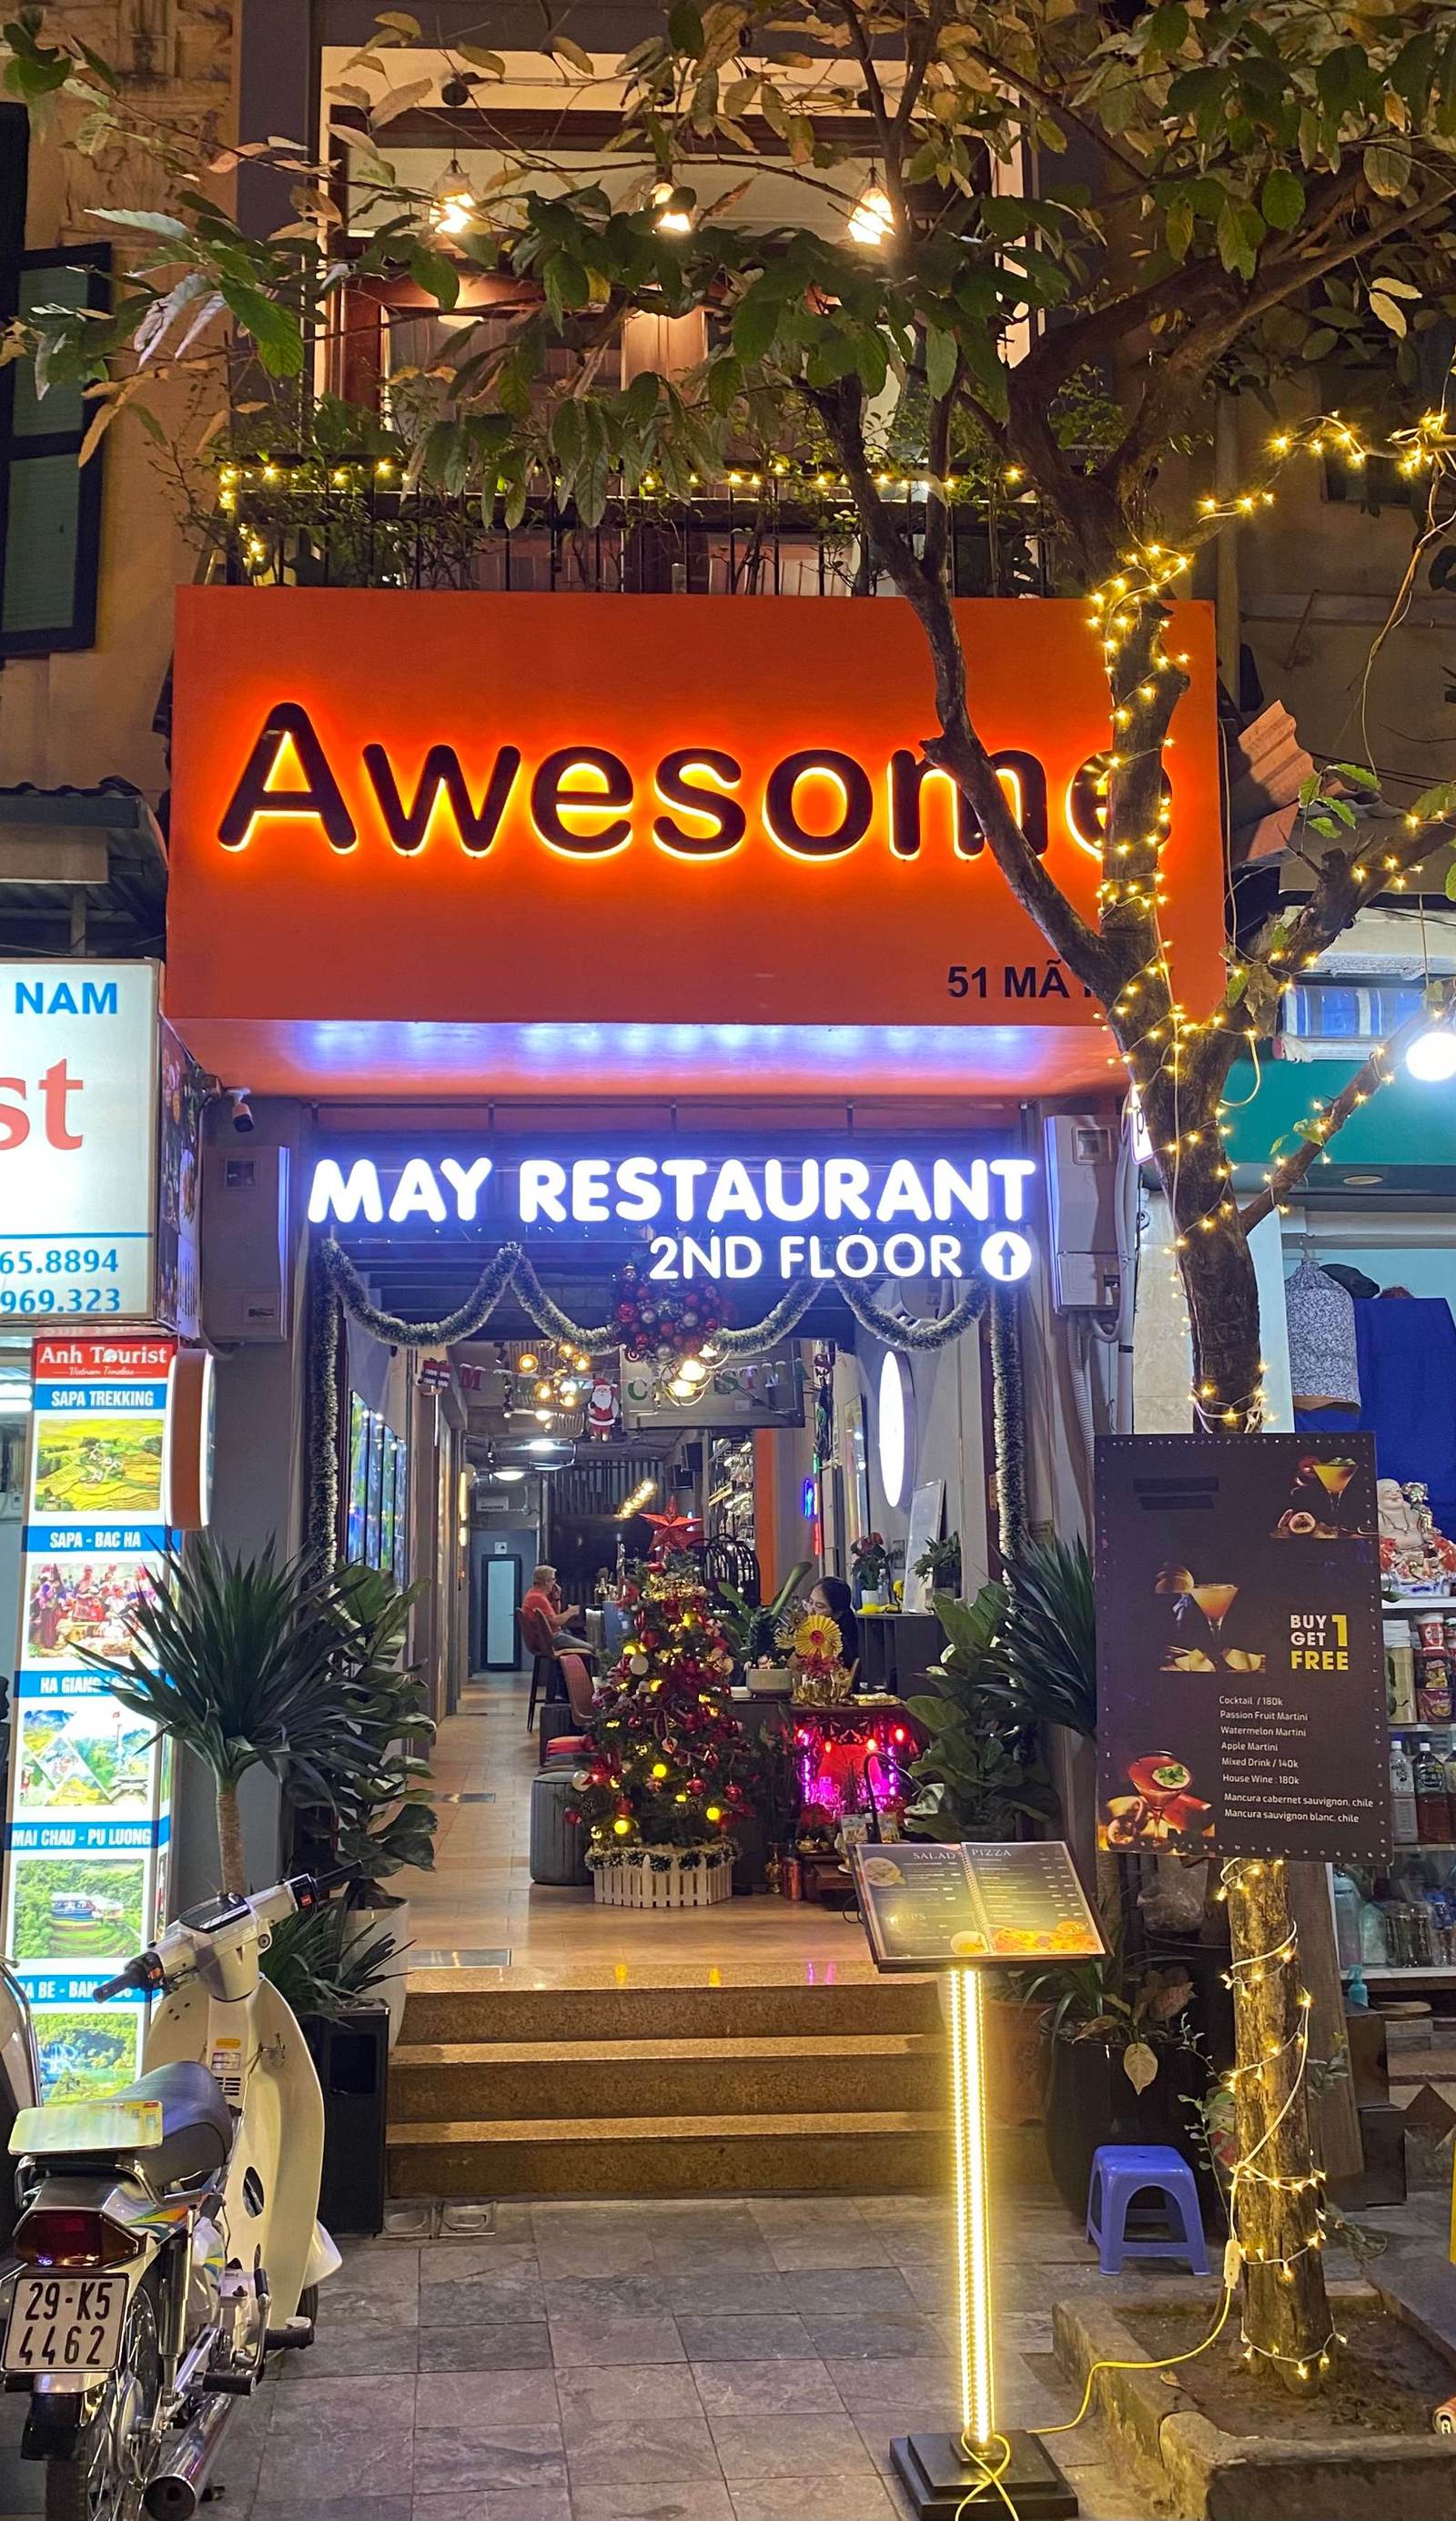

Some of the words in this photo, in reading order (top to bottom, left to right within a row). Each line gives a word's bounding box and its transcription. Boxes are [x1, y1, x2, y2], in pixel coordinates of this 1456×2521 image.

[946, 967, 986, 998] 51
[1004, 958, 1071, 998] MÃ
[15, 982, 117, 1014] NAM
[308, 1157, 492, 1223] MAY
[519, 1157, 1036, 1223] RESTAURANT
[649, 1235, 763, 1280] 2ND
[779, 1233, 963, 1280] FLOOR
[0, 1289, 120, 1314] 969.323
[40, 1344, 83, 1364] Anh
[90, 1346, 167, 1364] Tourist
[51, 1391, 86, 1407] SAPA
[89, 1391, 154, 1406] TREKKING
[50, 1532, 83, 1548] SAPA
[95, 1531, 121, 1548] BAC
[124, 1531, 142, 1547] HA
[1290, 1615, 1327, 1629] BUY
[1331, 1615, 1348, 1647] 1
[1290, 1631, 1326, 1646] GET
[1290, 1650, 1349, 1671] FREE
[40, 1677, 58, 1694] HA
[1218, 1696, 1253, 1706] Cocktail
[1262, 1697, 1283, 1706] 180k
[1220, 1710, 1253, 1719] Passion
[1255, 1711, 1276, 1720] Fruit
[1277, 1712, 1308, 1721] Martini
[1220, 1726, 1274, 1736] Watermelon
[1276, 1727, 1307, 1736] Martini
[1221, 1742, 1246, 1751] Apple
[1248, 1742, 1278, 1751] Martini
[1222, 1757, 1247, 1767] Mixed
[1248, 1757, 1270, 1767] Drink
[1279, 1758, 1299, 1768] 140k
[1222, 1774, 1250, 1783] House
[1250, 1775, 1273, 1784] Wine
[1279, 1775, 1299, 1785] 180k
[1224, 1793, 1261, 1803] Mancura
[1262, 1794, 1301, 1805] cabernet
[1352, 1798, 1374, 1807] chile
[1224, 1808, 1262, 1818] Mancura
[1263, 1810, 1309, 1822] sauvignon
[1338, 1813, 1360, 1823] chile
[11, 1829, 37, 1847] MAI
[41, 1829, 76, 1847] CHAU
[87, 1828, 106, 1846] PU
[109, 1827, 152, 1845] LUONG
[971, 1848, 1012, 1858] PIZZA
[38, 1981, 56, 1999] BE
[25, 2282, 113, 2321] 29-K5
[19, 2325, 105, 2366] 4462
